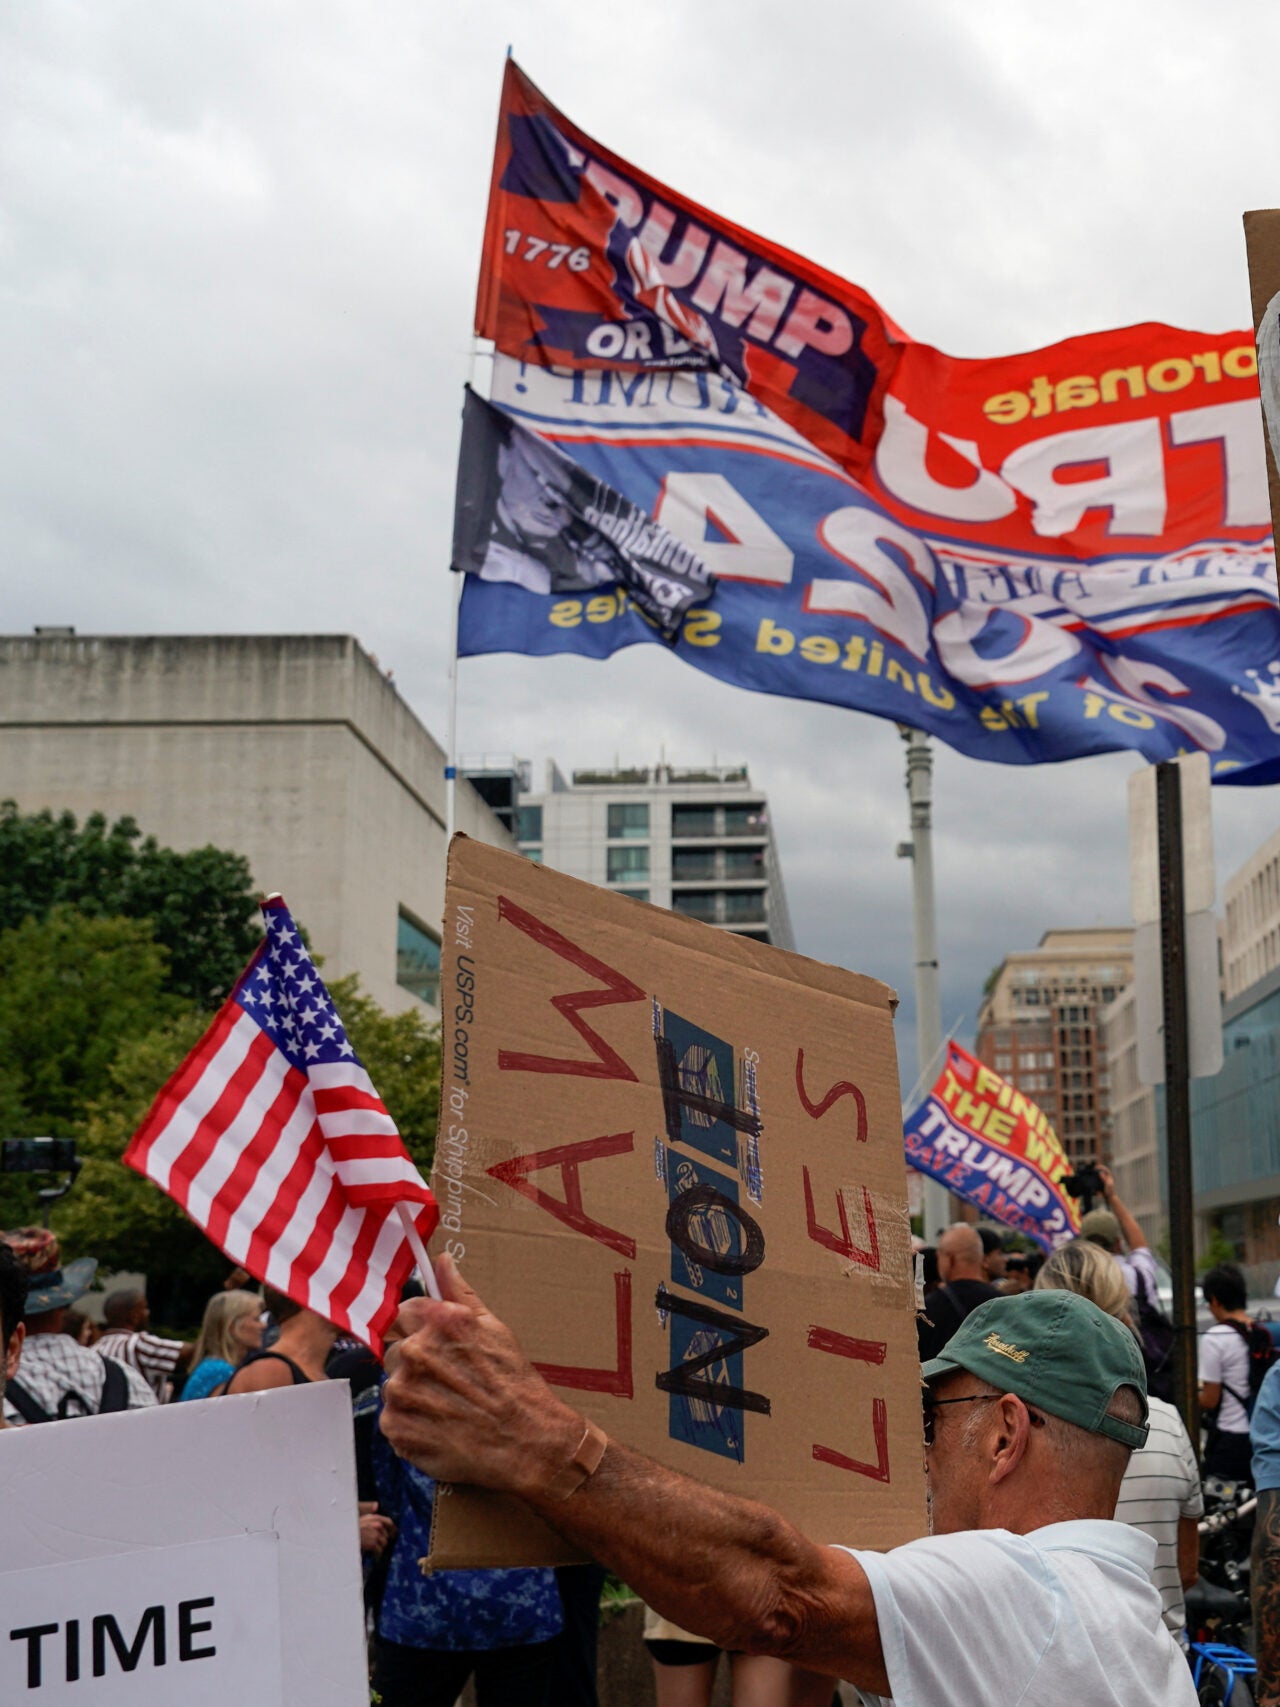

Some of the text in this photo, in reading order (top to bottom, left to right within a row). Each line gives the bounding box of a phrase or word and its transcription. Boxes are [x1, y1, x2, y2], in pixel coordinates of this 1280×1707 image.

[503, 229, 590, 272] 1776
[553, 128, 853, 357] RUMP
[586, 323, 654, 360] OR
[454, 904, 475, 950] Visit
[450, 1086, 469, 1121] for
[940, 1068, 1019, 1147] THE
[441, 1124, 469, 1234] Shipping
[486, 895, 647, 1400] LAW
[903, 1132, 973, 1188] SAVE
[917, 1101, 1051, 1209] TRUMP
[655, 1035, 772, 1418] NOT
[796, 1049, 891, 1484] LIES
[725, 1286, 738, 1300] 2
[9, 1596, 216, 1689] TIME
